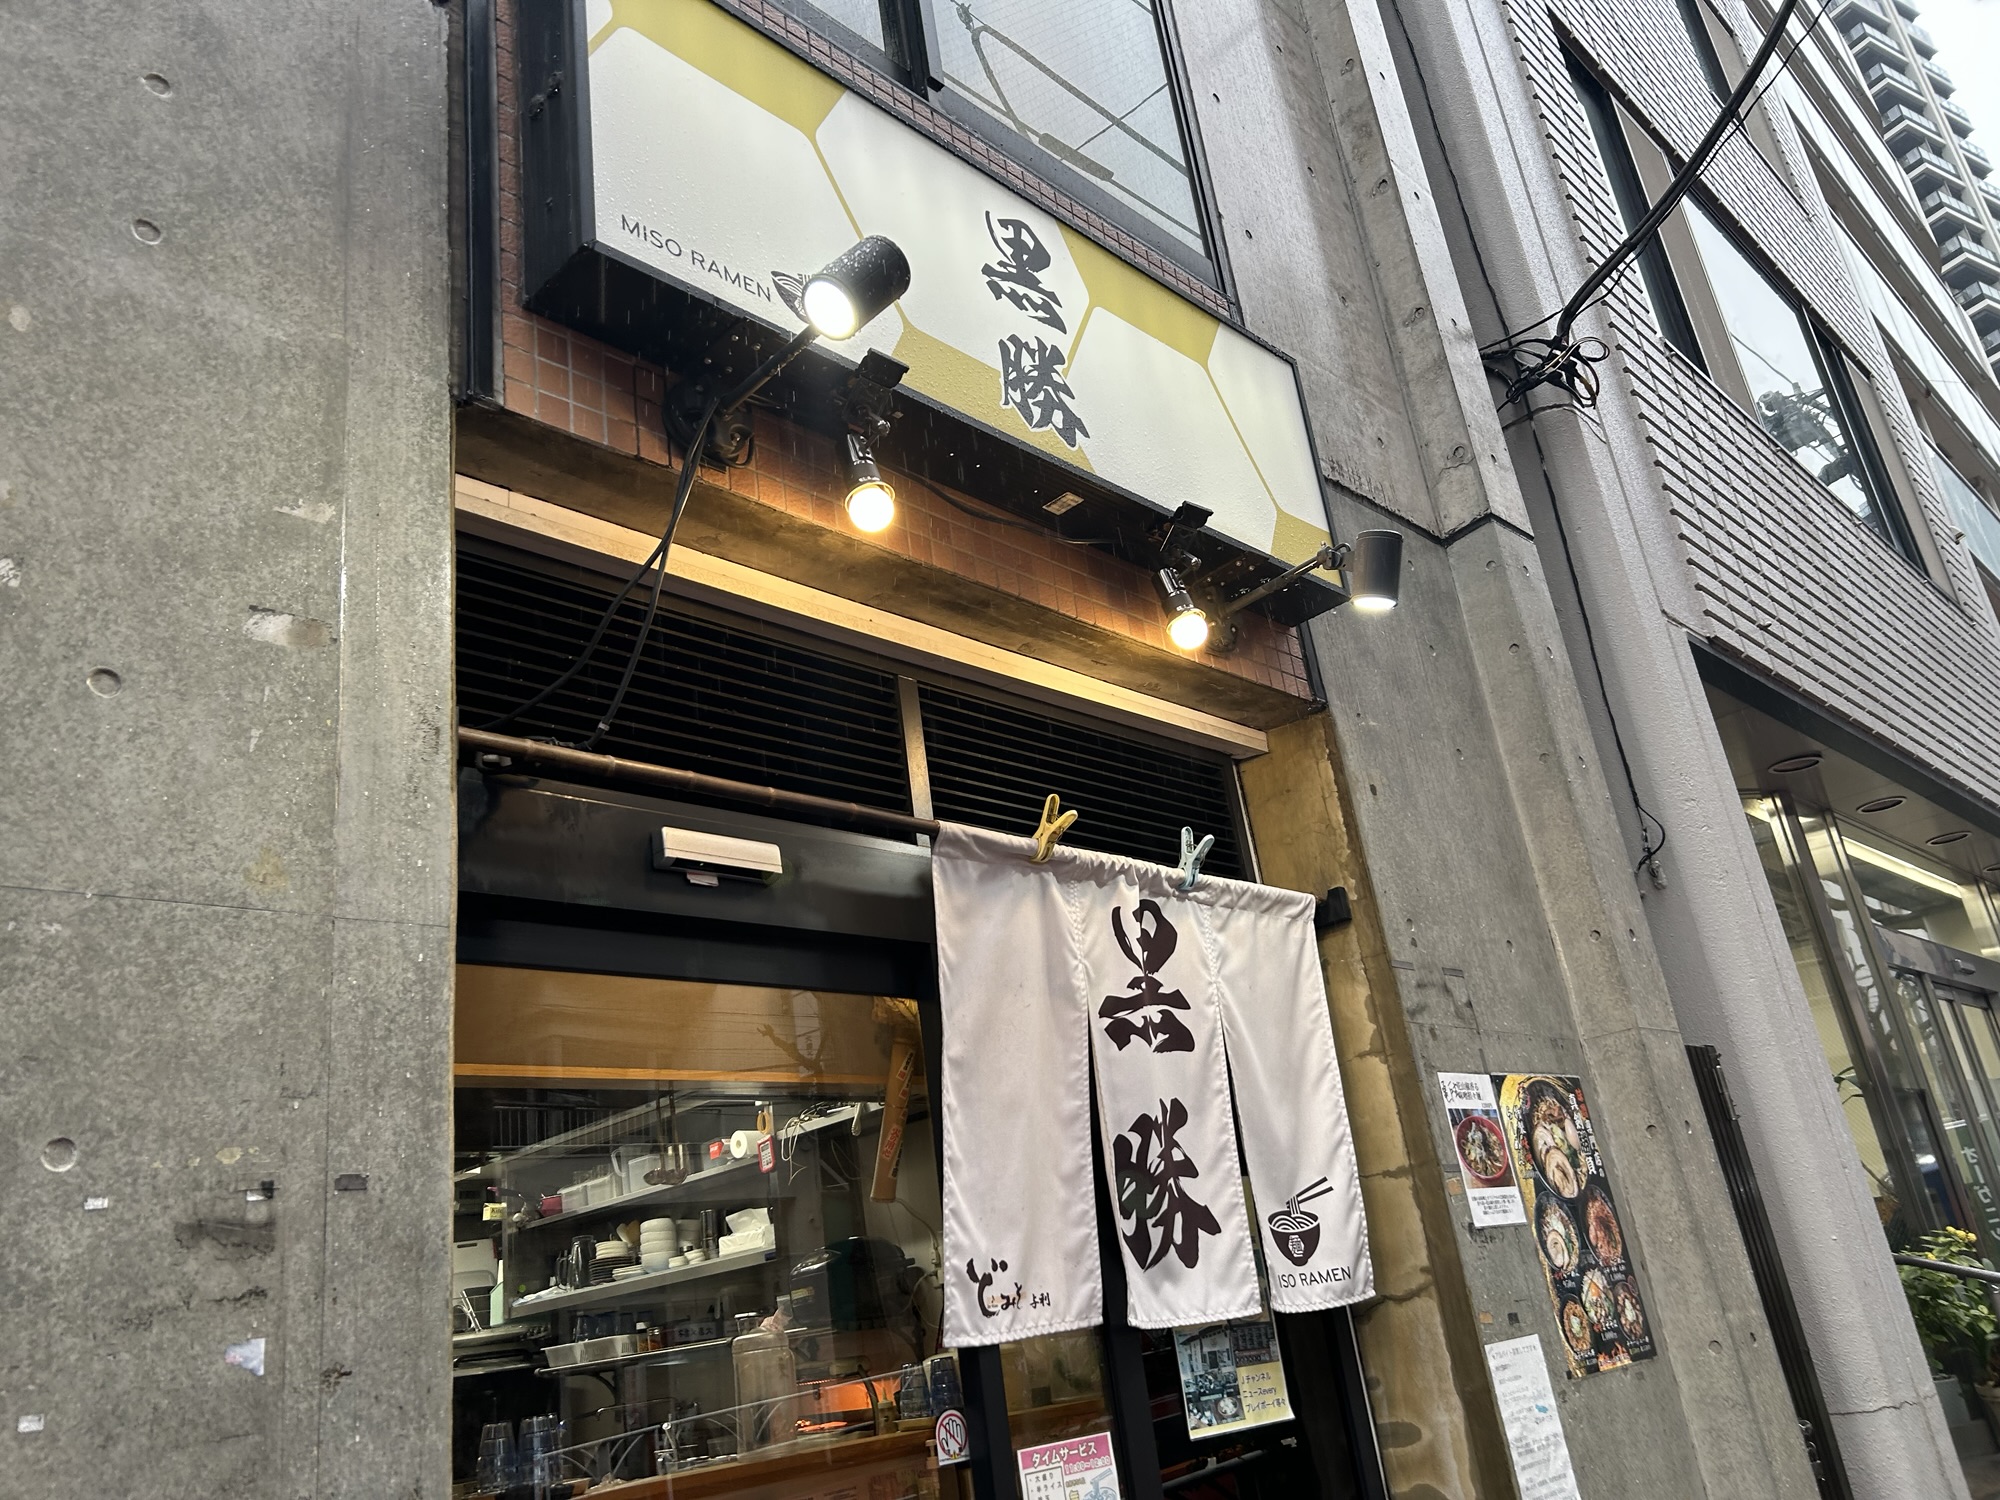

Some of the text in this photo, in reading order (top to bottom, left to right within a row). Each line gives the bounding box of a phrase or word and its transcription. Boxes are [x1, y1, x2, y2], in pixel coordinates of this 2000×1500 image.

[621, 214, 772, 302] MISO RAMEN
[1098, 899, 1222, 1272] 黒勝
[1299, 1266, 1352, 1287] RAMEN
[1031, 1441, 1098, 1469] タイムサービス
